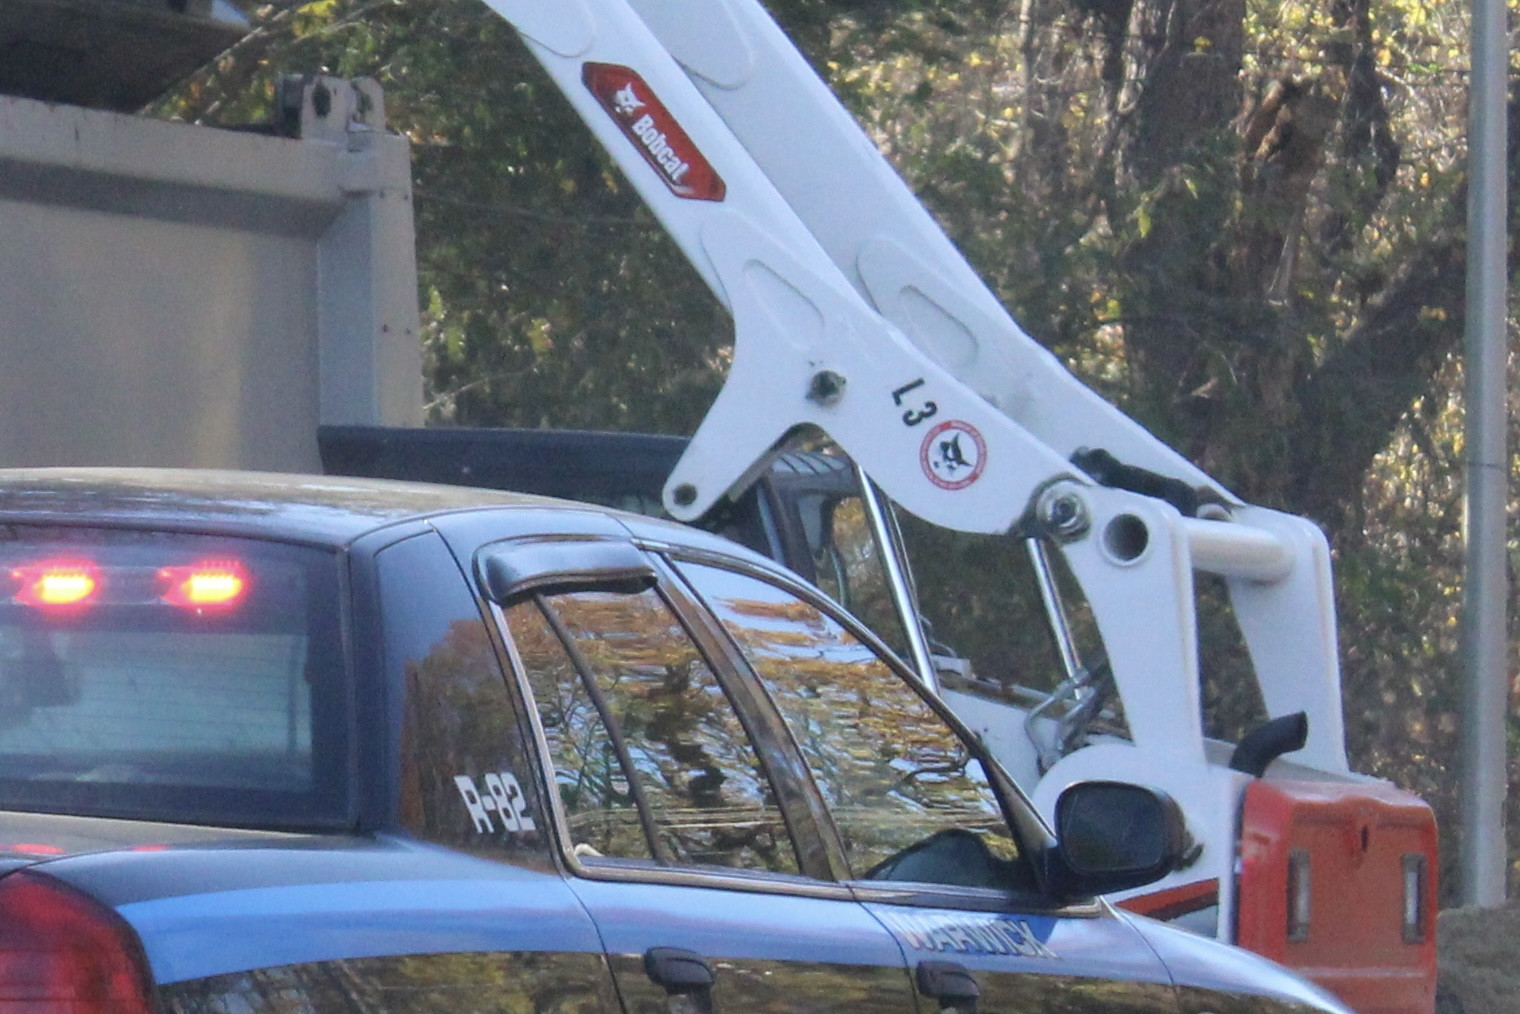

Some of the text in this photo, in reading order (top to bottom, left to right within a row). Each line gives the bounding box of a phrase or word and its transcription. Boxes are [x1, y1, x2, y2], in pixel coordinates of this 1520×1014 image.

[631, 113, 690, 181] Bobcat
[892, 378, 938, 427] L3
[453, 772, 537, 834] R-82
[880, 911, 1064, 961] WARWICK
